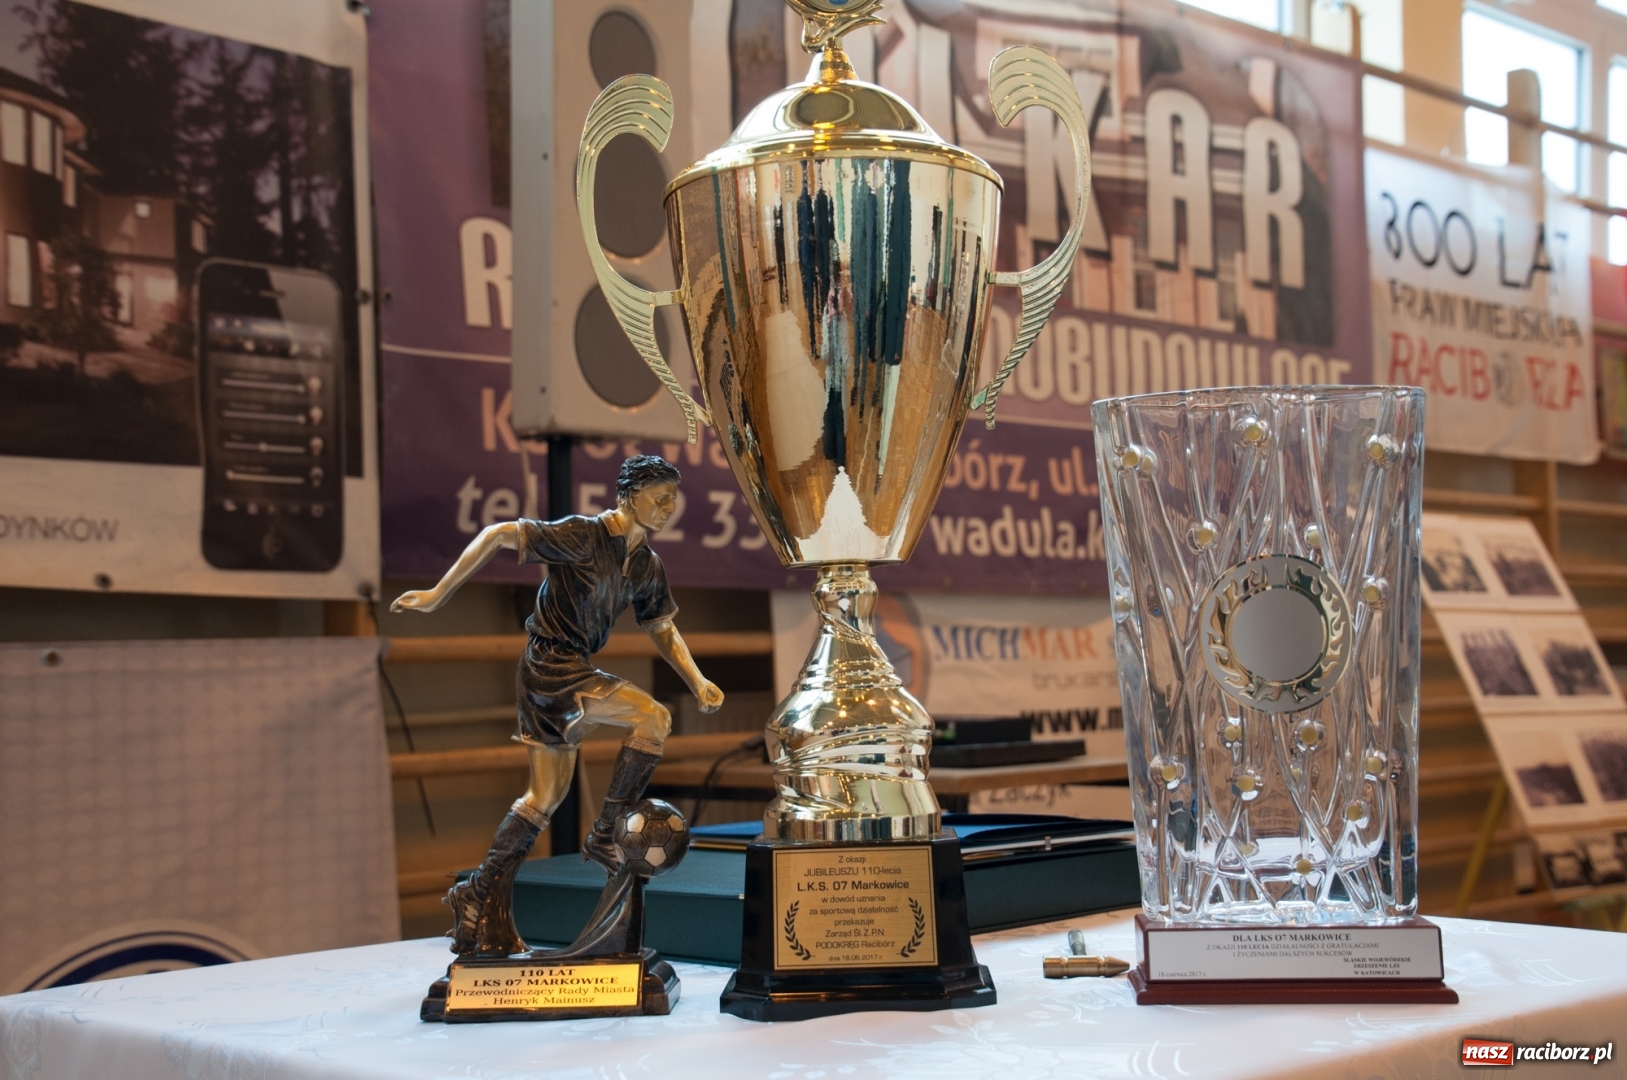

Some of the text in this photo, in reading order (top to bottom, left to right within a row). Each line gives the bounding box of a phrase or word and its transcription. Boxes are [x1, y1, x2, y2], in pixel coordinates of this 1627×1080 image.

[932, 624, 1099, 661] MICHMAR
[838, 855, 867, 865] Z okazji
[804, 867, 859, 877] JUBILEUSZU
[797, 879, 910, 892] L.K.S. 07 Markowice
[829, 894, 855, 903] dowód
[856, 894, 886, 903] uznania
[819, 906, 856, 917] sportową
[857, 905, 900, 915] działalność
[834, 917, 875, 927] przekazuje
[825, 929, 852, 939] Zarząd
[1232, 934, 1252, 942] DLA
[1254, 934, 1273, 942] LKS
[1288, 933, 1352, 941] MARKOWICE
[815, 939, 895, 950] PODOKRĘG Racibórz
[1270, 942, 1320, 950] DZIAŁALNOŚCI
[842, 953, 878, 961] 18.06.2017
[1315, 949, 1353, 957] SUKCESÓW
[519, 968, 576, 977] 110 LAT
[473, 979, 501, 987] LKS
[526, 977, 619, 986] MARKOWICE
[455, 985, 635, 997] Przewodniczący Rady Miasta
[493, 995, 596, 1006] Henryk Mainusz
